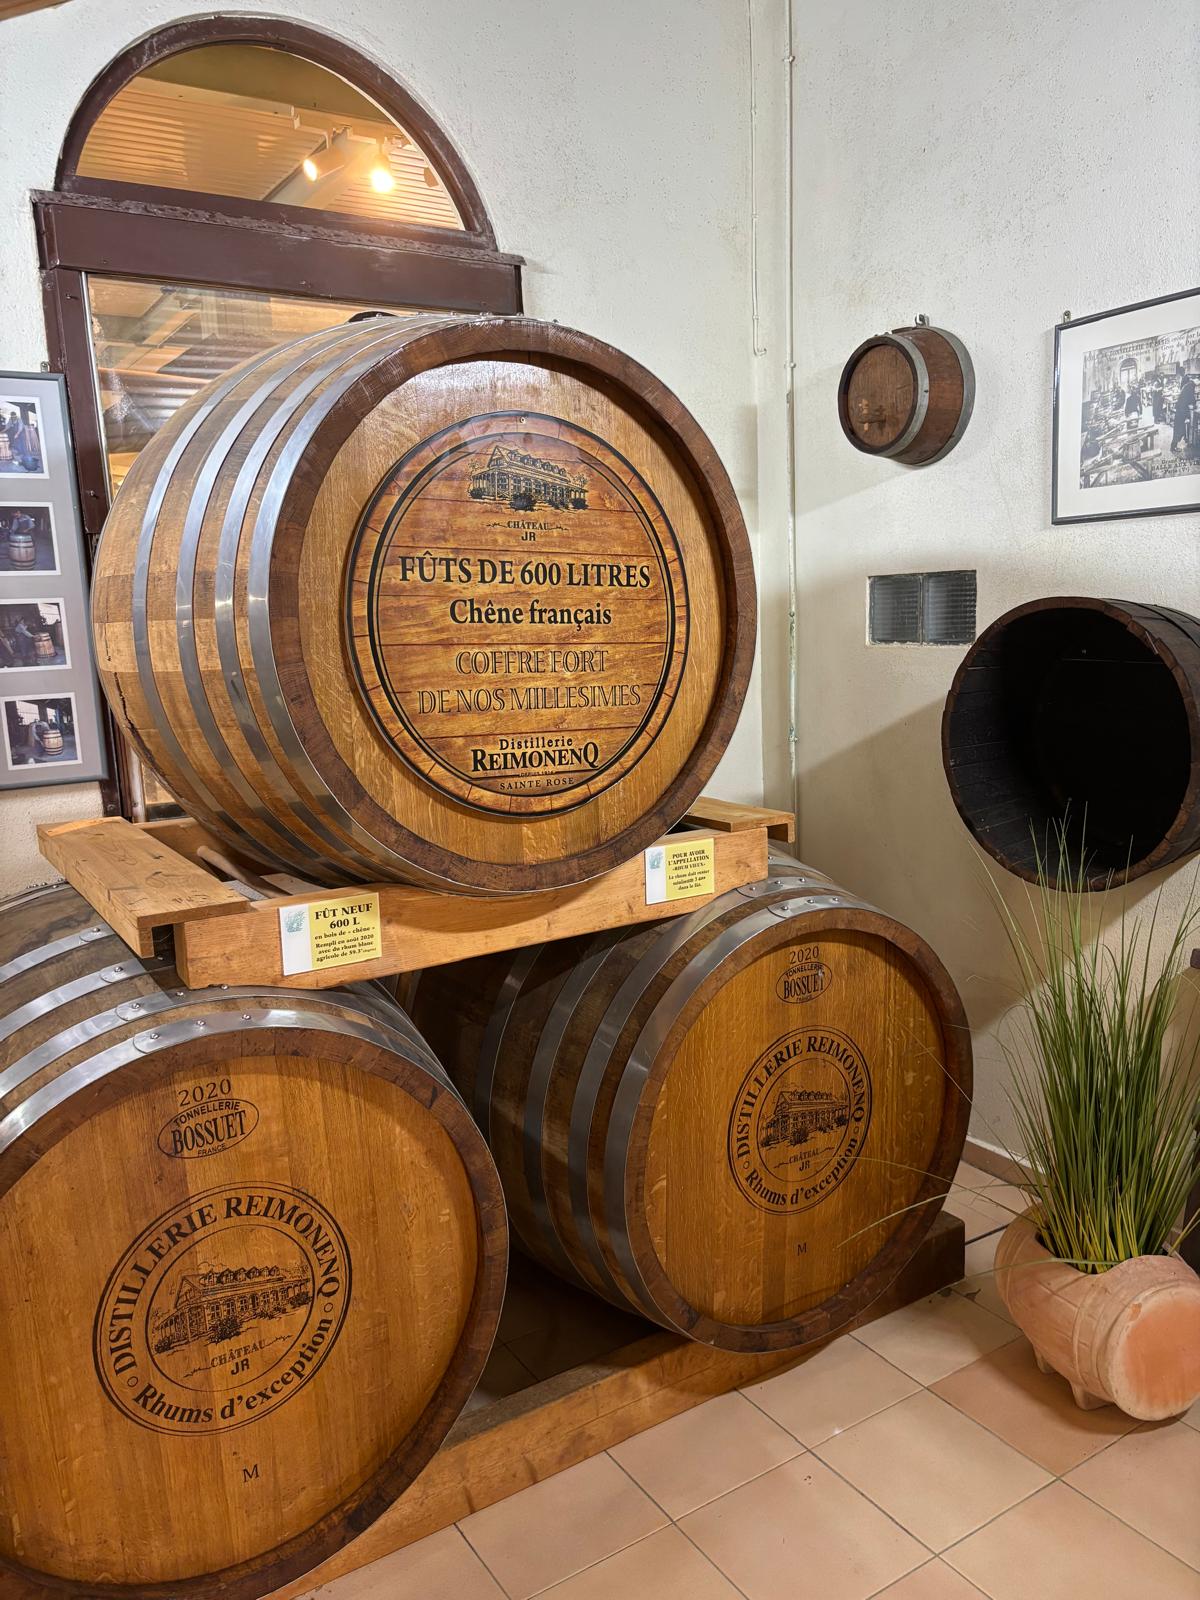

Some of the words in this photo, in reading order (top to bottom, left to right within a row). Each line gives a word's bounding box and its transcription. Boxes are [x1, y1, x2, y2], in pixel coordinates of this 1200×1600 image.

[507, 520, 549, 531] CHÂTEAU
[521, 531, 536, 541] JR
[399, 551, 472, 584] FÛTS
[478, 558, 515, 585] DE
[521, 562, 562, 586] 600
[566, 563, 651, 588] LITRES
[450, 599, 523, 625] Chêne
[529, 600, 612, 631] français
[456, 650, 546, 675] COFFRE
[550, 650, 608, 673] FORT
[417, 690, 453, 714] DE
[456, 687, 505, 713] NOS
[510, 684, 641, 711] MILLESIMES
[499, 736, 573, 751] Distillerie
[471, 742, 599, 772] REIMONENQ
[500, 780, 541, 790] SAINTE
[546, 777, 575, 787] ROSE
[315, 908, 338, 920] FÛT
[341, 903, 373, 916] NEUF
[330, 918, 349, 929] 600
[353, 917, 360, 926] L
[315, 940, 337, 949] Rempli
[790, 945, 819, 964] 2020
[316, 953, 340, 962] agricole
[783, 971, 825, 999] BOSSUET
[178, 1079, 231, 1106] 2020
[736, 1038, 803, 1159] DISTILLERIE
[805, 1035, 866, 1124] REIMONENQ
[173, 1101, 241, 1128] TONNELLERIE
[171, 1110, 247, 1155] BOSSUET
[197, 1143, 226, 1155] FRANCE
[745, 1167, 788, 1206] Rhums
[790, 1137, 858, 1206] d'exception
[799, 1161, 810, 1171] JR
[797, 1243, 807, 1255] M
[107, 1202, 218, 1377] DISTILLERIE
[222, 1195, 341, 1300] REIMONENQ
[210, 1344, 267, 1368] CHÂTEAU
[230, 1357, 251, 1376] JR
[132, 1381, 214, 1424] Rhums
[219, 1317, 334, 1421] d'exception
[242, 1463, 260, 1483] M
